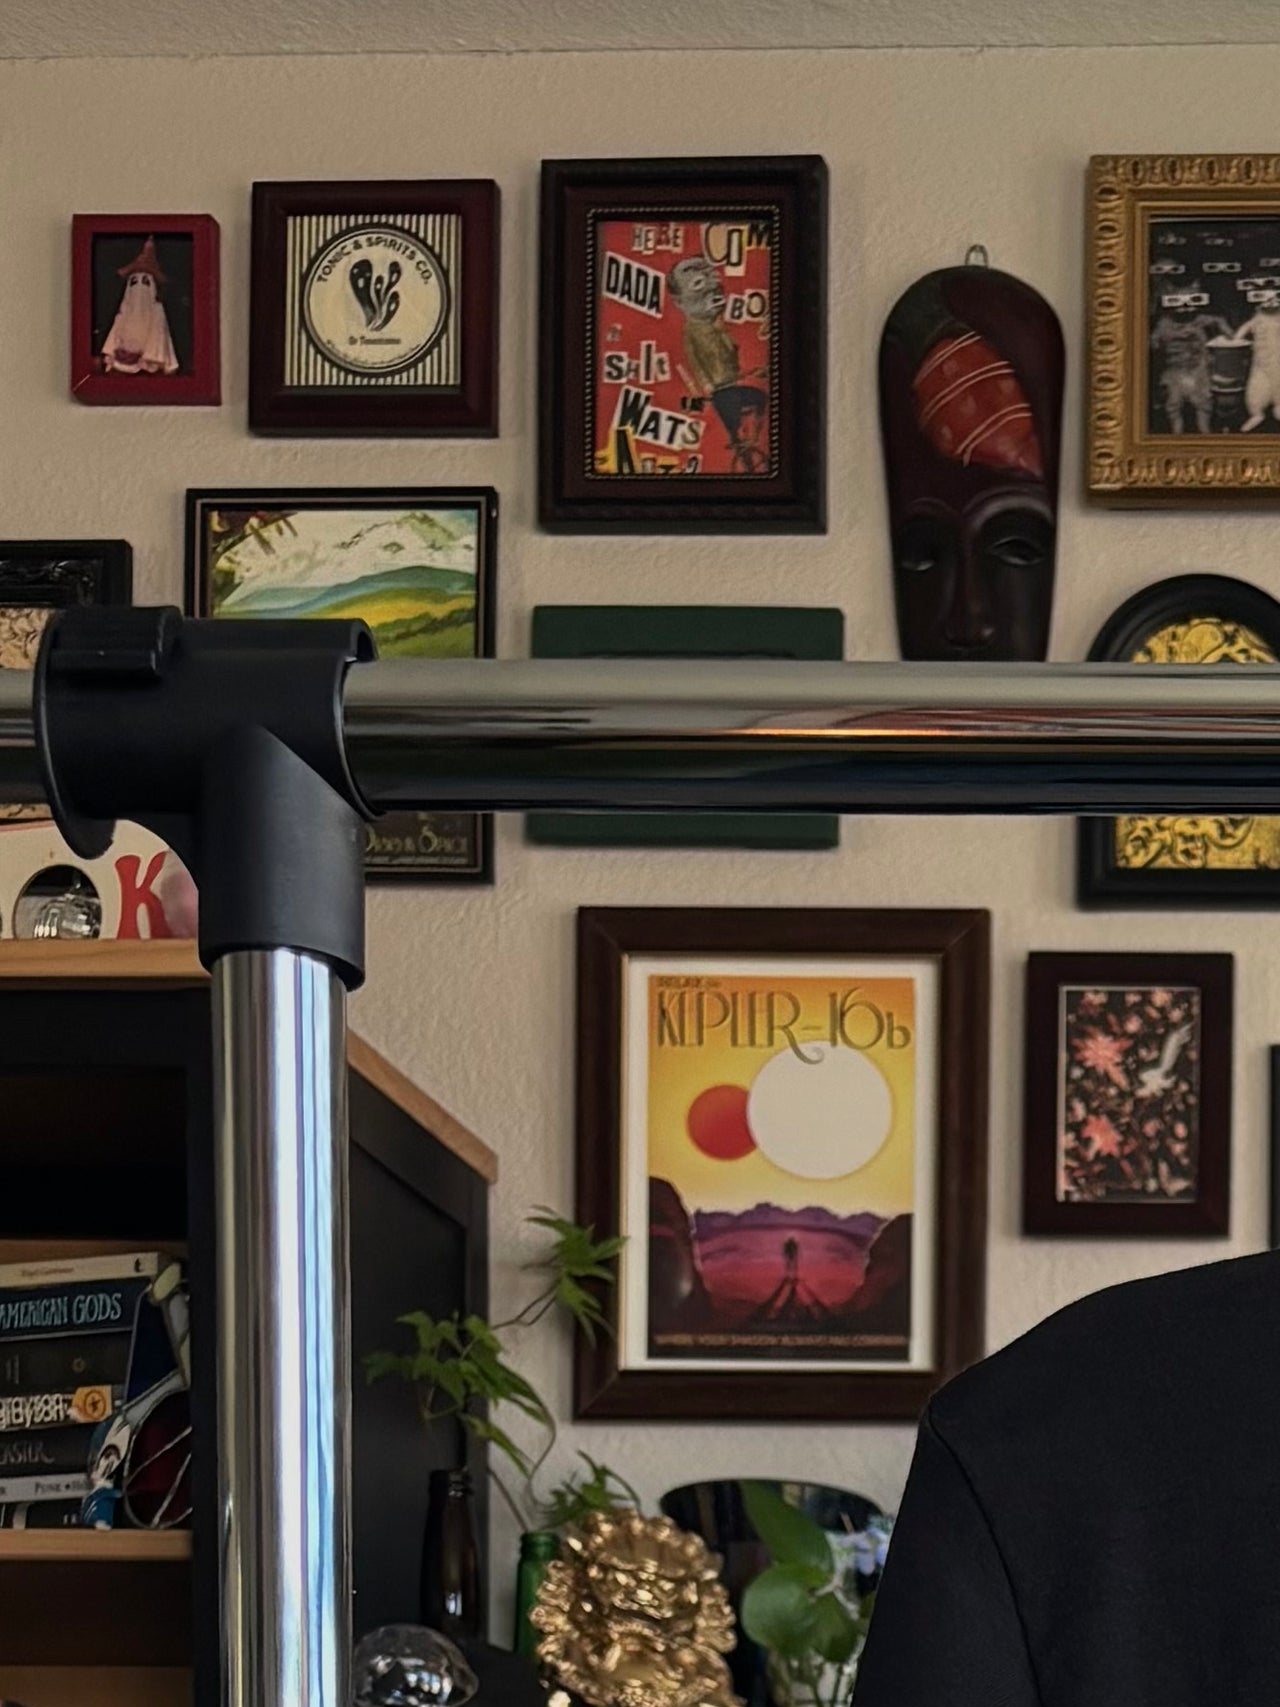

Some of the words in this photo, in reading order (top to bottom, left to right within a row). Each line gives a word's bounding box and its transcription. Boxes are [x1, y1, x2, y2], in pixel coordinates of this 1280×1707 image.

[317, 245, 351, 283] TONIC
[352, 239, 363, 250] &
[366, 236, 417, 261] SPIRITS
[605, 255, 662, 316] DADA
[72, 1293, 122, 1325] GODS
